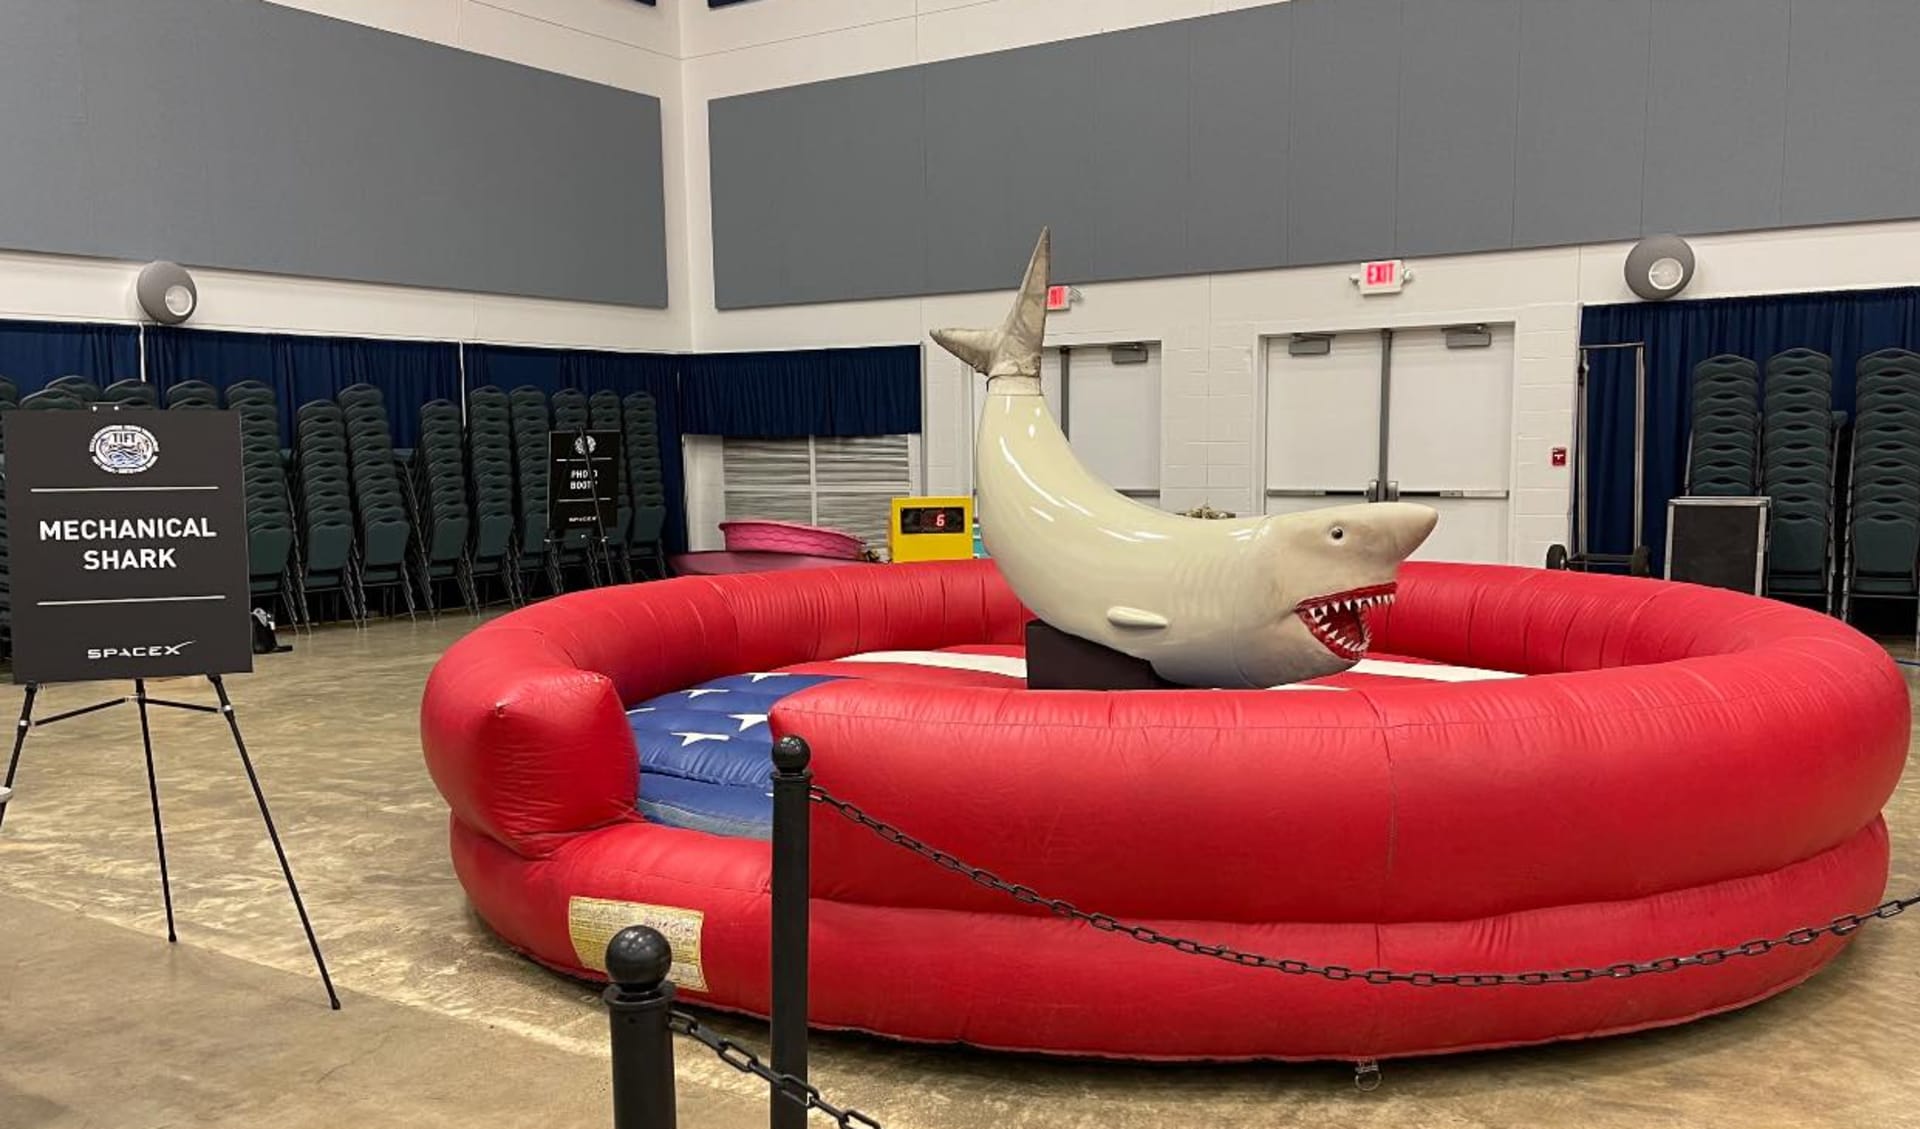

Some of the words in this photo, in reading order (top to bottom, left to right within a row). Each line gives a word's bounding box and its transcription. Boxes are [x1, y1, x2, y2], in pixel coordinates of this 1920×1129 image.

[1367, 263, 1395, 285] EXIT
[112, 433, 137, 443] TIFT
[570, 469, 598, 479] PHOO
[570, 481, 598, 490] BOOT
[936, 513, 946, 527] 6
[39, 517, 217, 541] MECHANICAL
[83, 548, 177, 570] SHARK
[87, 640, 197, 659] SPACEX
